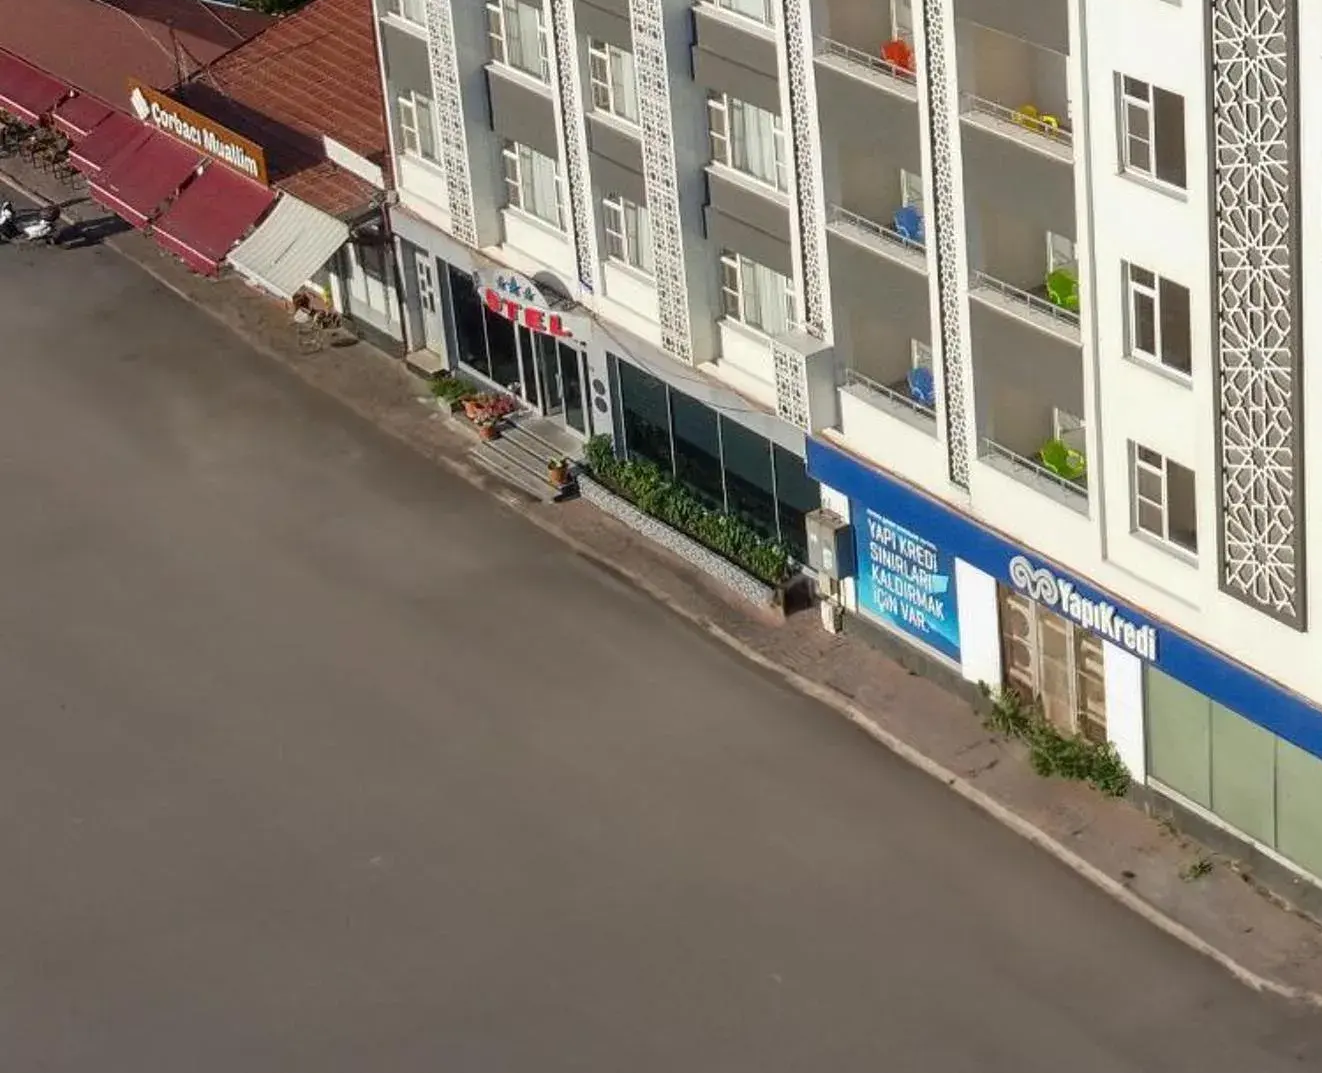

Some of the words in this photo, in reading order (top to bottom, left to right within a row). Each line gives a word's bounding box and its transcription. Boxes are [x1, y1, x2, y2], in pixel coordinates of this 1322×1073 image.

[867, 517, 897, 550] YAPI
[871, 563, 945, 621] KALDIRMAK
[1057, 579, 1157, 661] YapıKredi
